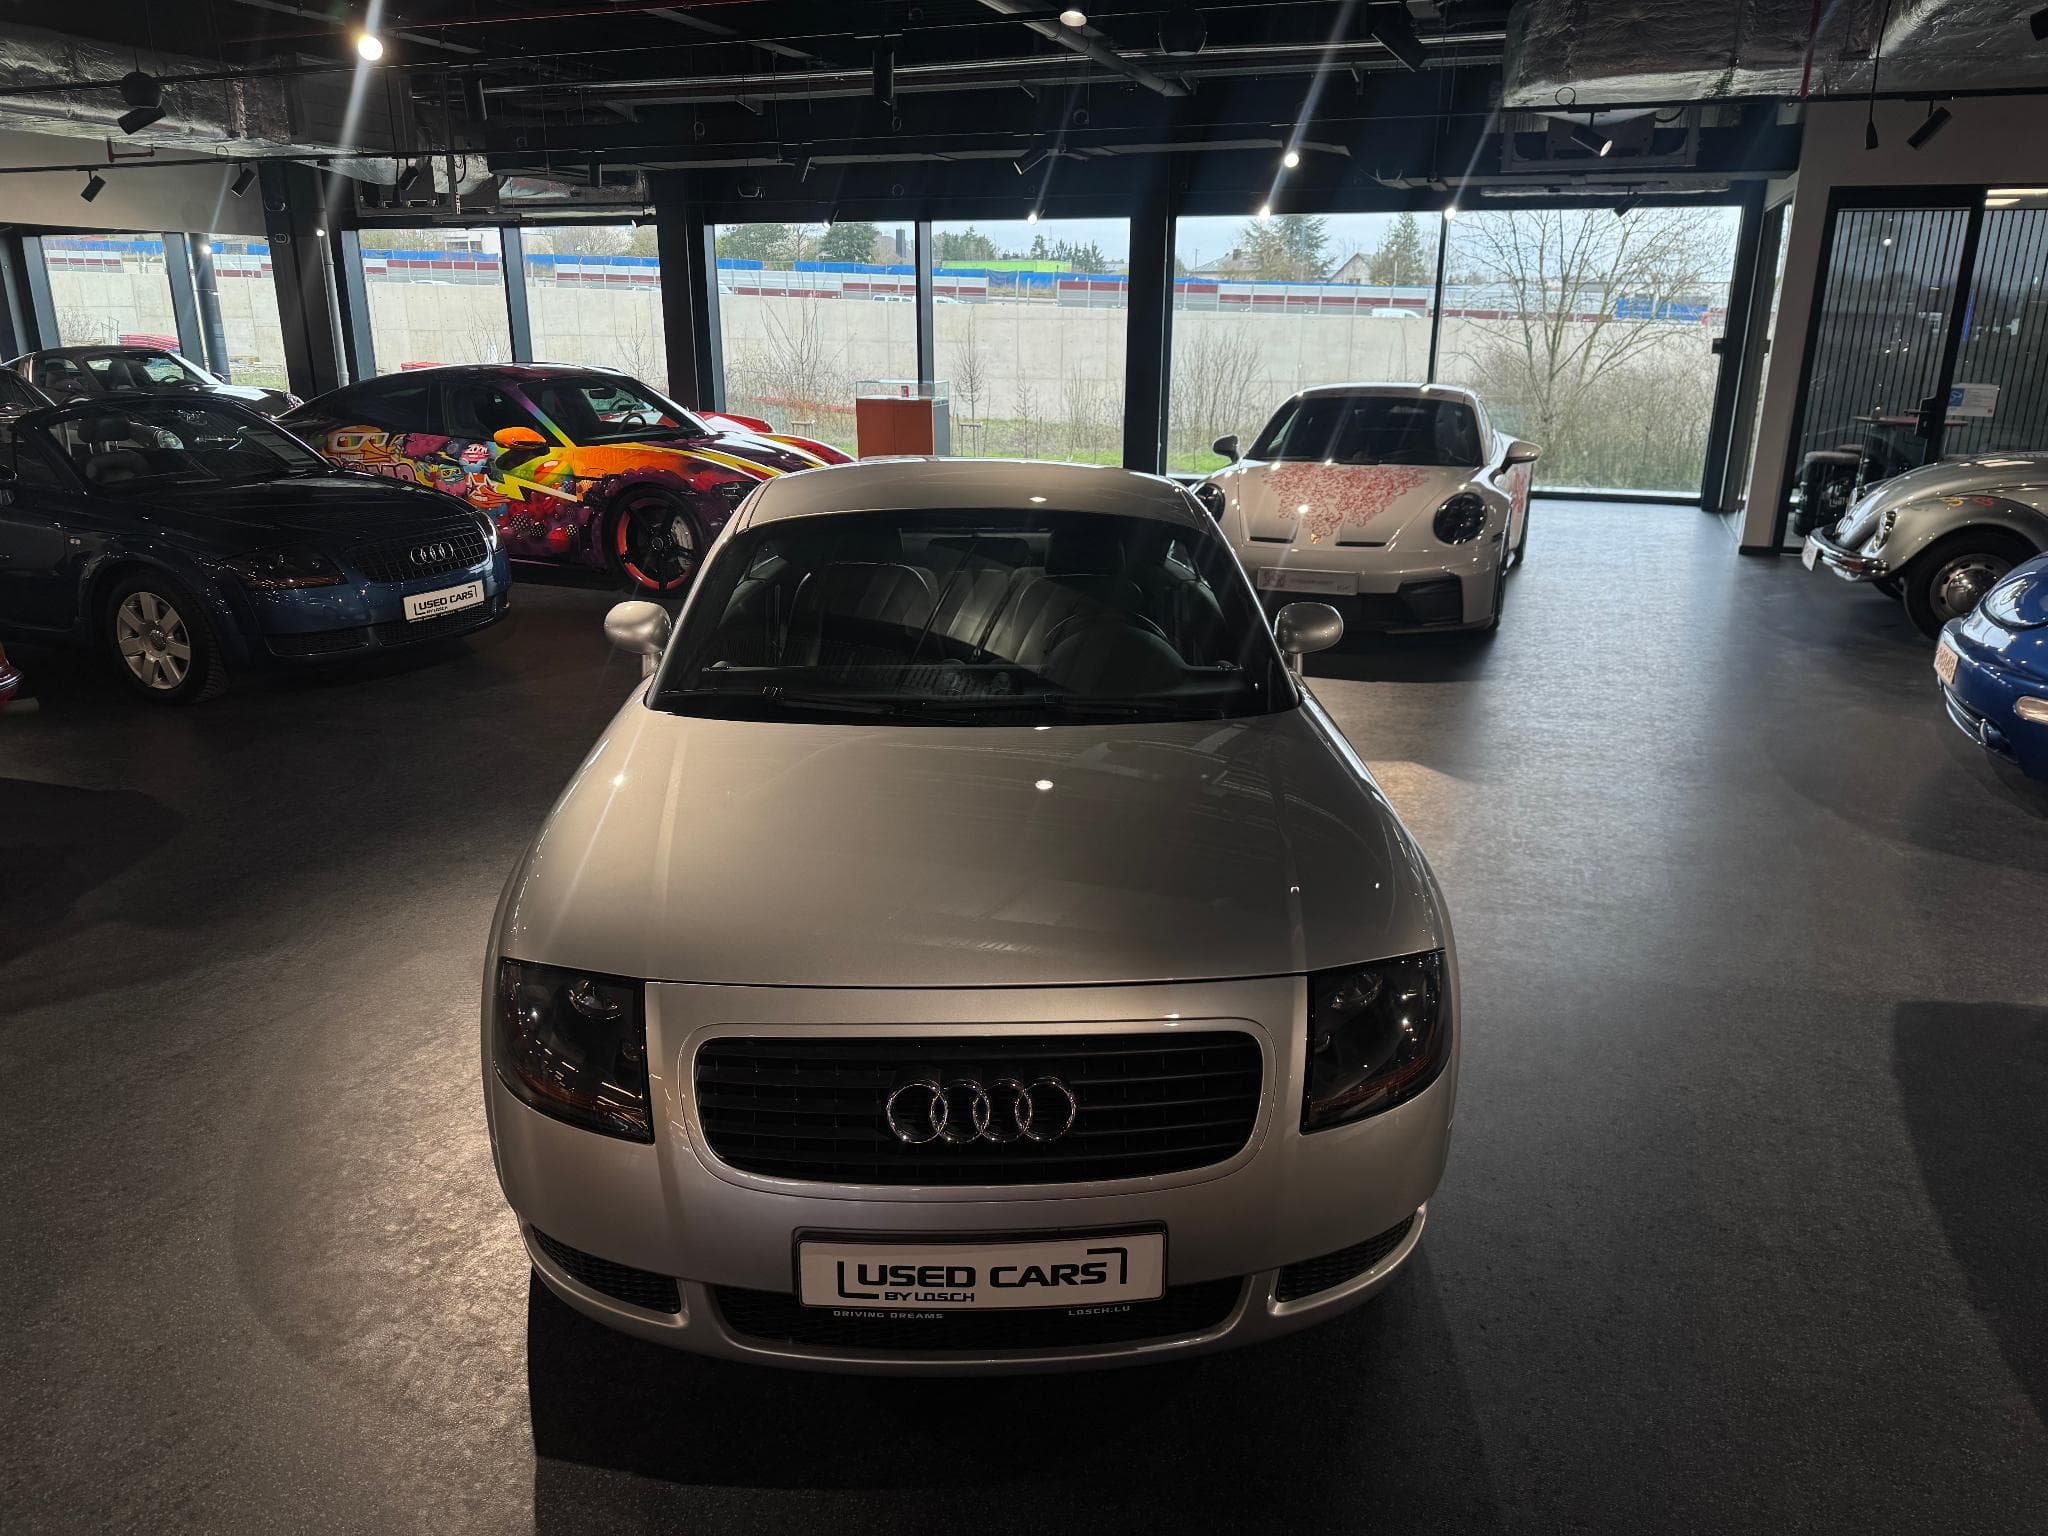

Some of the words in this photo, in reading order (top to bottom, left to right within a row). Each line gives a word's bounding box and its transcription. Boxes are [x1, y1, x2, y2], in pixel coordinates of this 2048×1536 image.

[419, 597, 447, 610] USED
[450, 590, 473, 603] CARS
[857, 1264, 976, 1288] USED
[990, 1262, 1108, 1288] CARS
[885, 1291, 912, 1301] BY
[915, 1291, 975, 1302] LOSCH
[833, 1309, 885, 1319] DRIVING
[890, 1311, 944, 1320] DREAMS
[1068, 1305, 1131, 1317] LOSCH.LU
